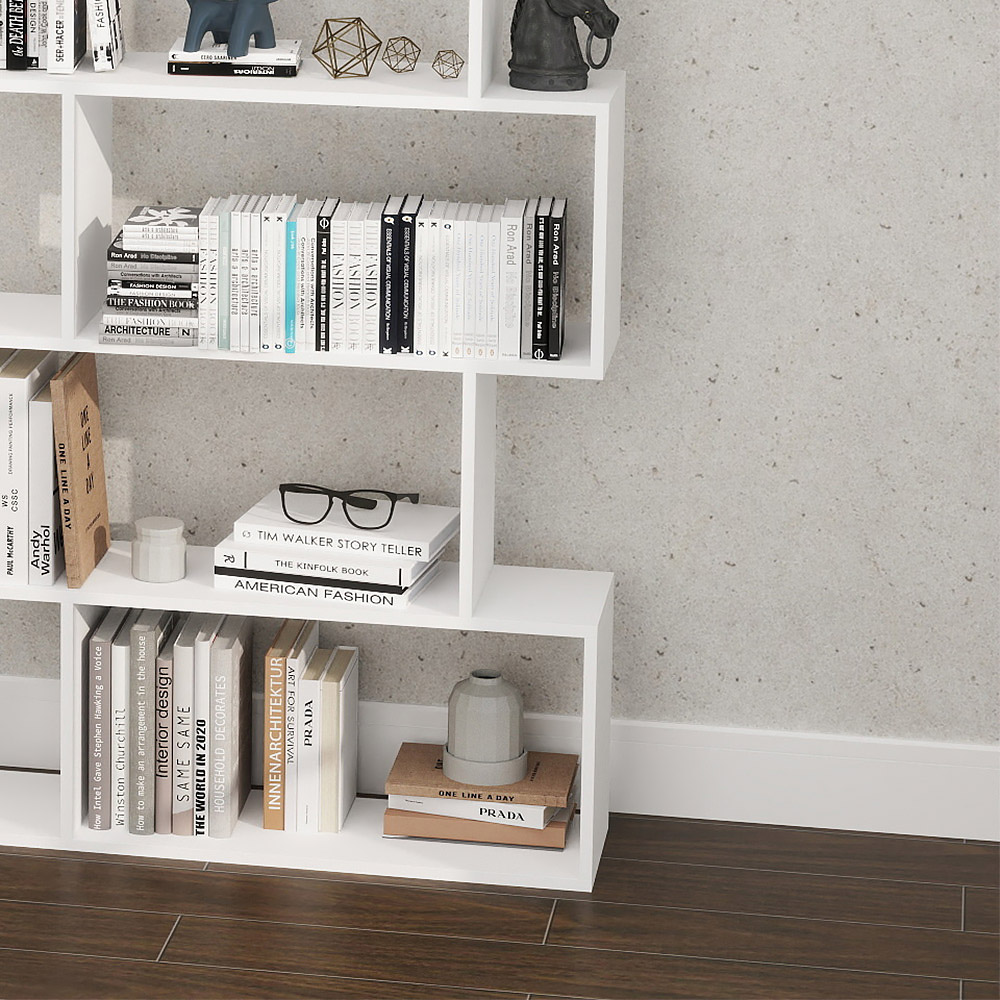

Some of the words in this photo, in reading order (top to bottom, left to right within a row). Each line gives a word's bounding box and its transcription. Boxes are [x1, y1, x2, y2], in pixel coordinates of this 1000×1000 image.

[9, 15, 23, 45] DEATH
[507, 224, 517, 241] Ron
[506, 244, 517, 265] Arad
[109, 298, 127, 306] THE
[128, 299, 167, 307] FASHION
[105, 325, 170, 335] ARCHITECTURE
[2, 495, 8, 507] WS
[11, 489, 19, 512] CSSC
[58, 443, 66, 464] ONE
[64, 508, 72, 530] DAY
[31, 530, 43, 569] Andy
[41, 525, 51, 576] Warhol
[257, 530, 278, 541] TIM
[282, 533, 333, 548] WALKER
[338, 539, 376, 552] STORY
[381, 544, 422, 557] TELLER
[275, 560, 293, 568] THE
[297, 561, 338, 573] KINFOLK
[342, 566, 369, 576] BOOK
[234, 580, 318, 598] AMERICAN
[324, 589, 394, 606] FASHION
[94, 646, 102, 671] Voice
[94, 685, 103, 719] Hawking
[137, 686, 145, 696] in
[155, 666, 172, 718] design
[287, 692, 295, 712] FOR
[215, 676, 226, 740] DECORATES
[304, 700, 313, 746] PRADA
[94, 724, 103, 758] Stephen
[115, 708, 125, 771] Churchill
[138, 702, 147, 756] arrangement
[177, 706, 190, 749] SAME
[196, 720, 206, 751] 2020
[268, 657, 284, 810] INNENARCHITEKTUR
[287, 715, 295, 764] SURVIVAL
[156, 723, 168, 777] Interior
[196, 754, 205, 766] IN
[94, 762, 102, 782] Gave
[139, 761, 144, 771] an
[177, 759, 190, 802] SAME
[213, 749, 225, 813] HOUSEHOLD
[115, 778, 125, 826] Winston
[137, 801, 144, 810] to
[196, 770, 205, 812] WORLD
[136, 816, 144, 831] How
[195, 815, 205, 836] THE
[479, 808, 524, 821] PRADA
